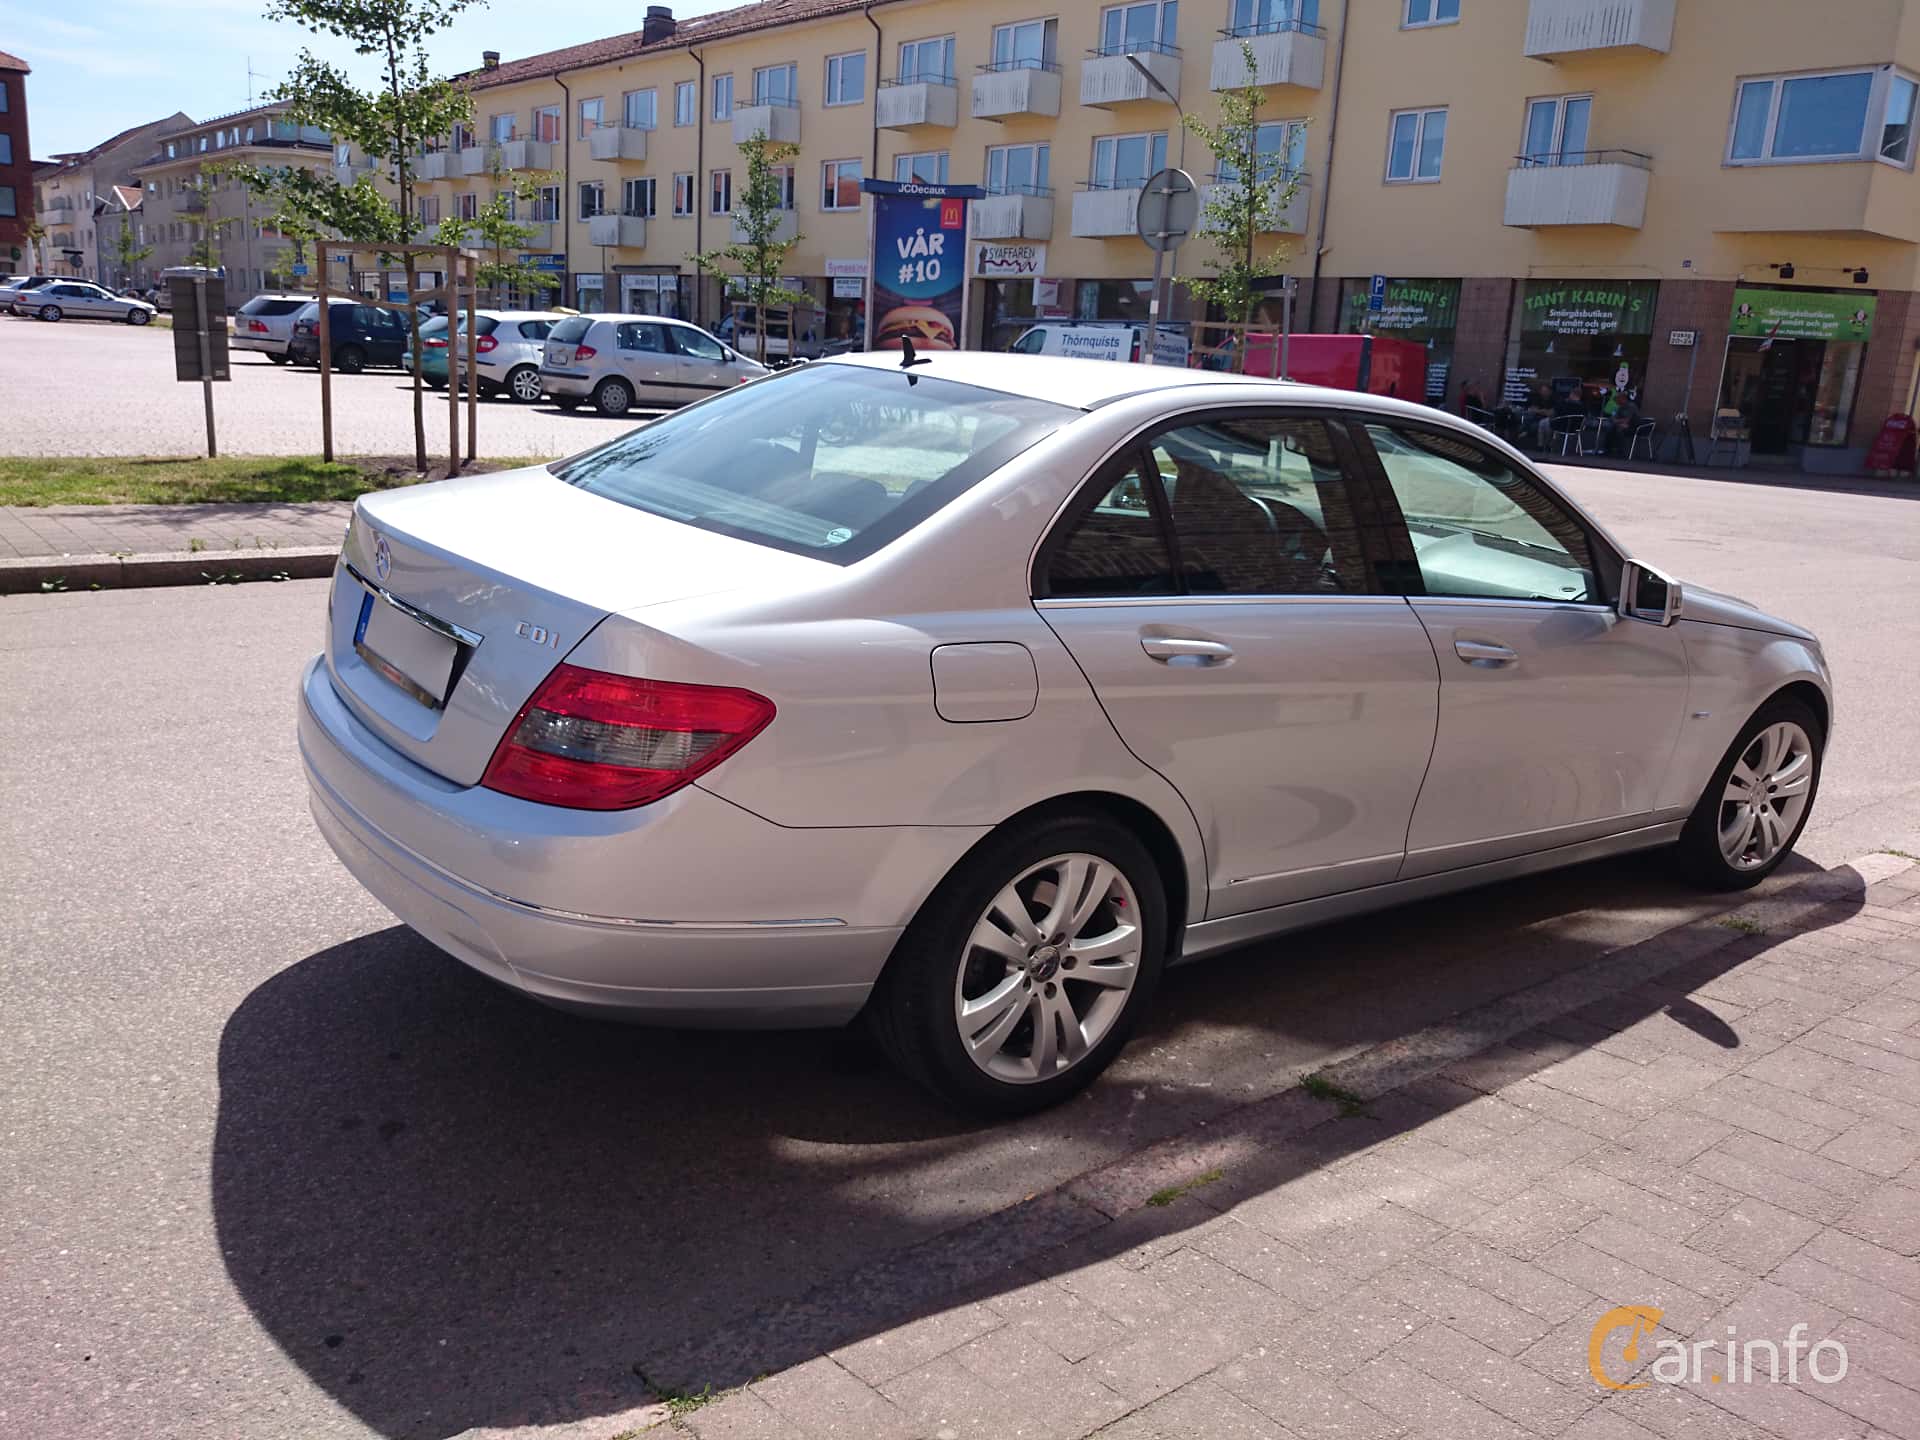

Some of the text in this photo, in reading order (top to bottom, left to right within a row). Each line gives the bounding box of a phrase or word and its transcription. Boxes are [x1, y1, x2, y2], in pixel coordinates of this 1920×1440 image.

[898, 183, 947, 195] JCDecaux
[897, 228, 945, 259] VÅR
[898, 259, 941, 284] #10
[1374, 276, 1384, 294] P
[1525, 290, 1567, 310] TANT
[1542, 318, 1560, 327] med
[1584, 320, 1599, 328] och
[1600, 320, 1618, 330] gott
[1061, 333, 1120, 349] Thörnquists
[515, 620, 560, 649] CDI
